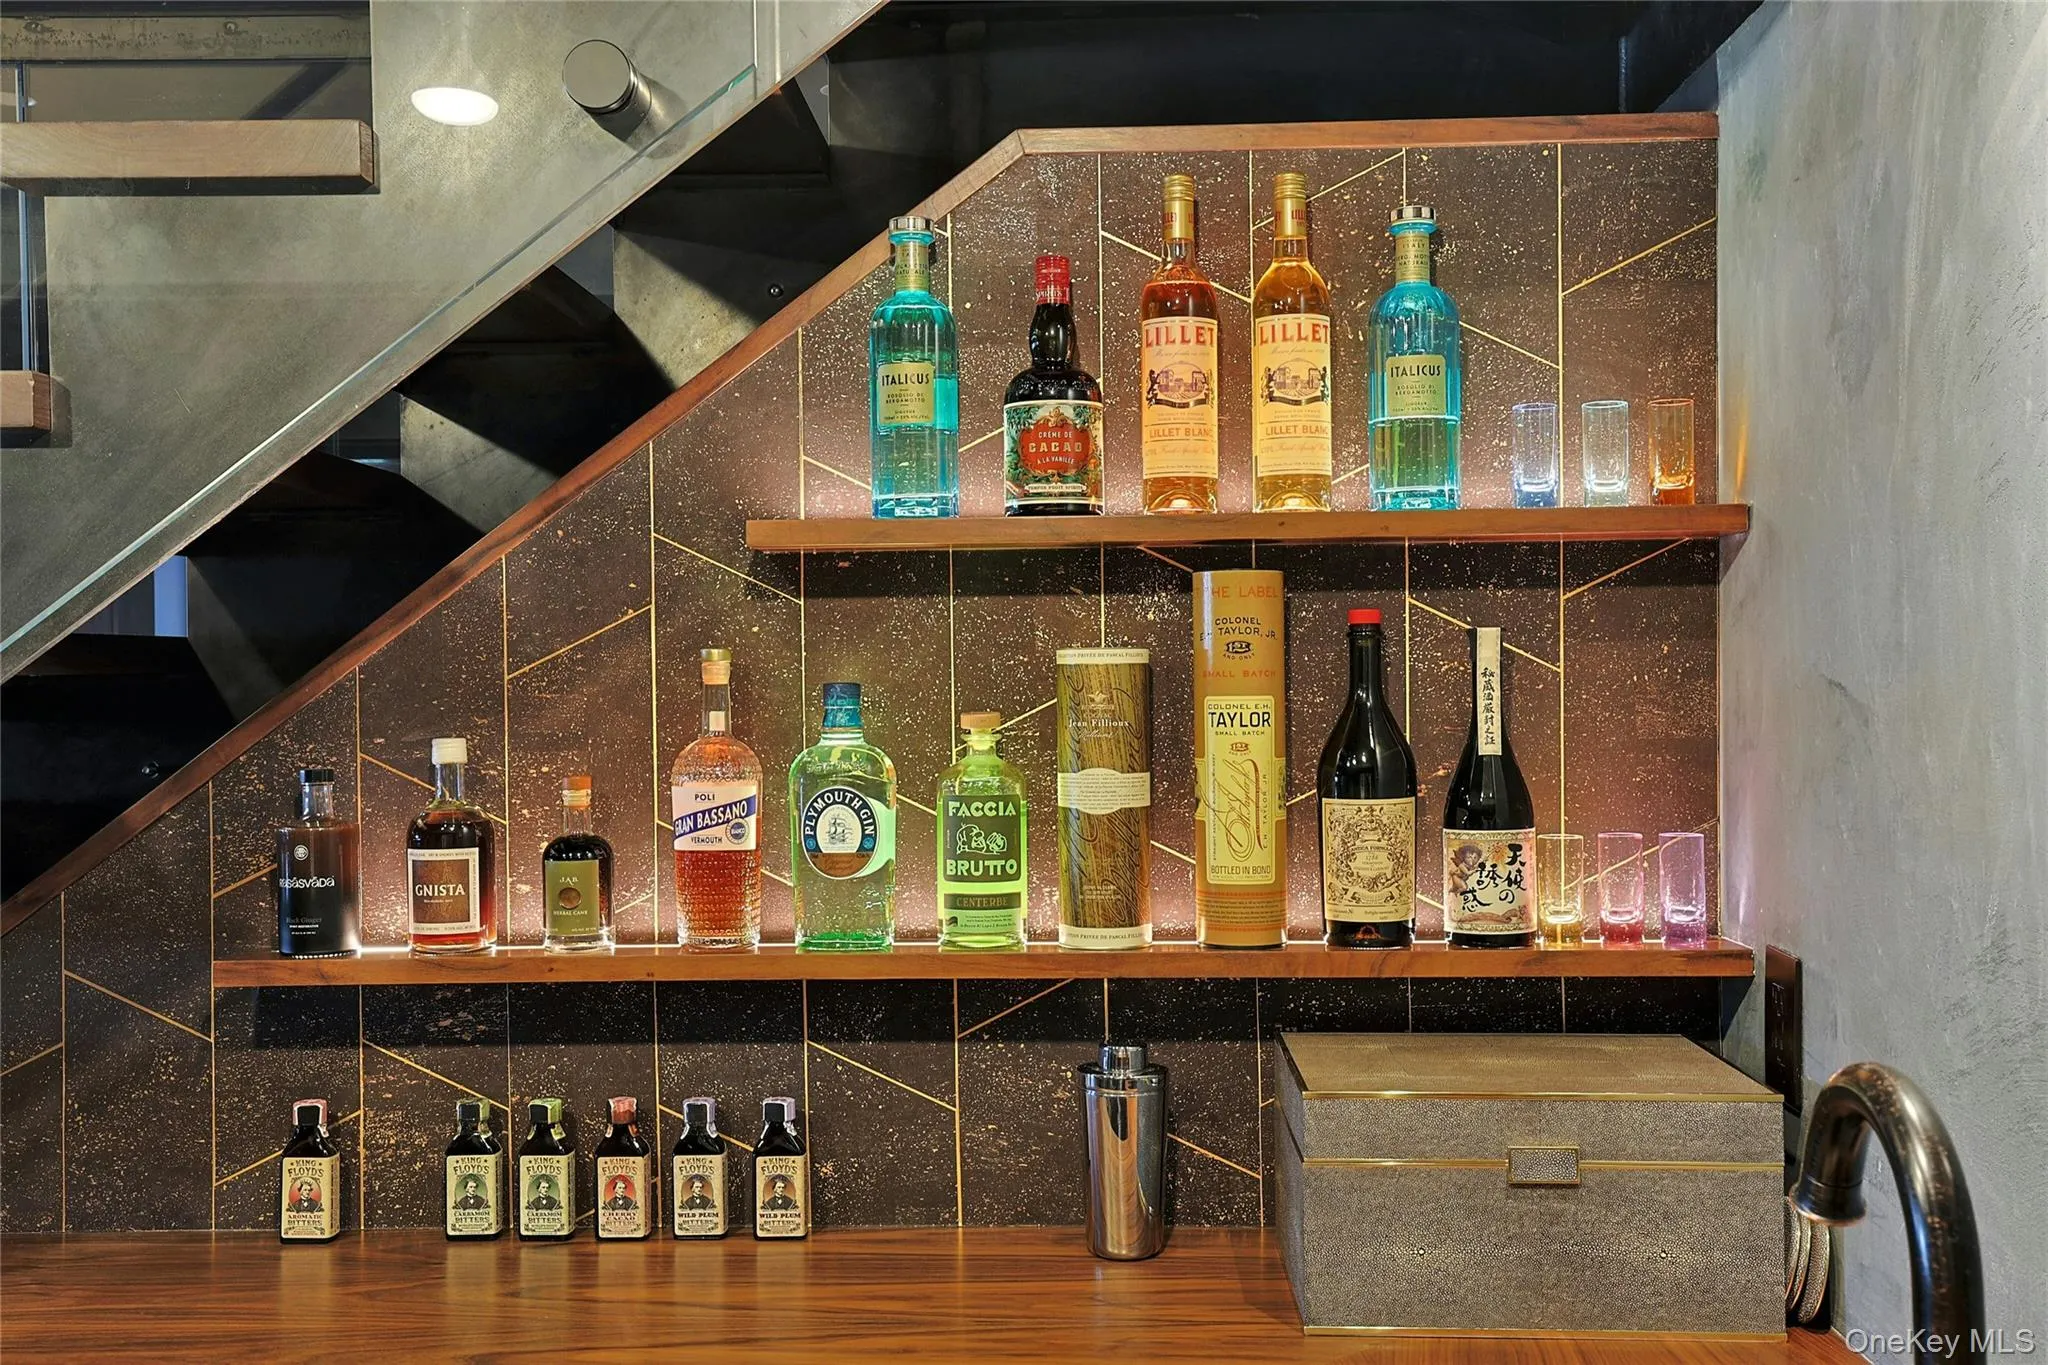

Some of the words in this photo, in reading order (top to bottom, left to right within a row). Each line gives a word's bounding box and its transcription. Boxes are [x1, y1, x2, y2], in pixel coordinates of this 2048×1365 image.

[1145, 325, 1215, 349] LILLET
[1259, 322, 1329, 346] LILLET
[1390, 364, 1441, 378] ITALICUS
[881, 372, 930, 387] ITALICUS
[1149, 427, 1181, 439] LILLET
[1265, 425, 1299, 436] LILLET
[1028, 441, 1083, 453] CACAO
[1239, 585, 1279, 598] LABEL
[1214, 616, 1262, 625] COLONEL
[1202, 669, 1236, 678] SMALL
[1243, 669, 1276, 678] BATCH
[1091, 718, 1129, 727] Fillioux
[1208, 711, 1271, 728] TAYLOR
[694, 793, 716, 801] POLI
[696, 799, 748, 829] BASSANO
[804, 790, 863, 836] PLYMOUTH
[859, 808, 875, 835] GIN
[948, 801, 1018, 817] FACCIA
[690, 836, 723, 844] VERMOUTH
[946, 858, 1018, 877] BRUTTO
[1210, 865, 1241, 875] BOTTLED
[415, 883, 466, 897] GNISTA
[956, 897, 1009, 908] CENTERBE
[295, 1159, 317, 1167] KING
[460, 1157, 482, 1165] KING
[533, 1157, 554, 1165] KING
[686, 1157, 707, 1165] KING
[768, 1157, 790, 1165] KING
